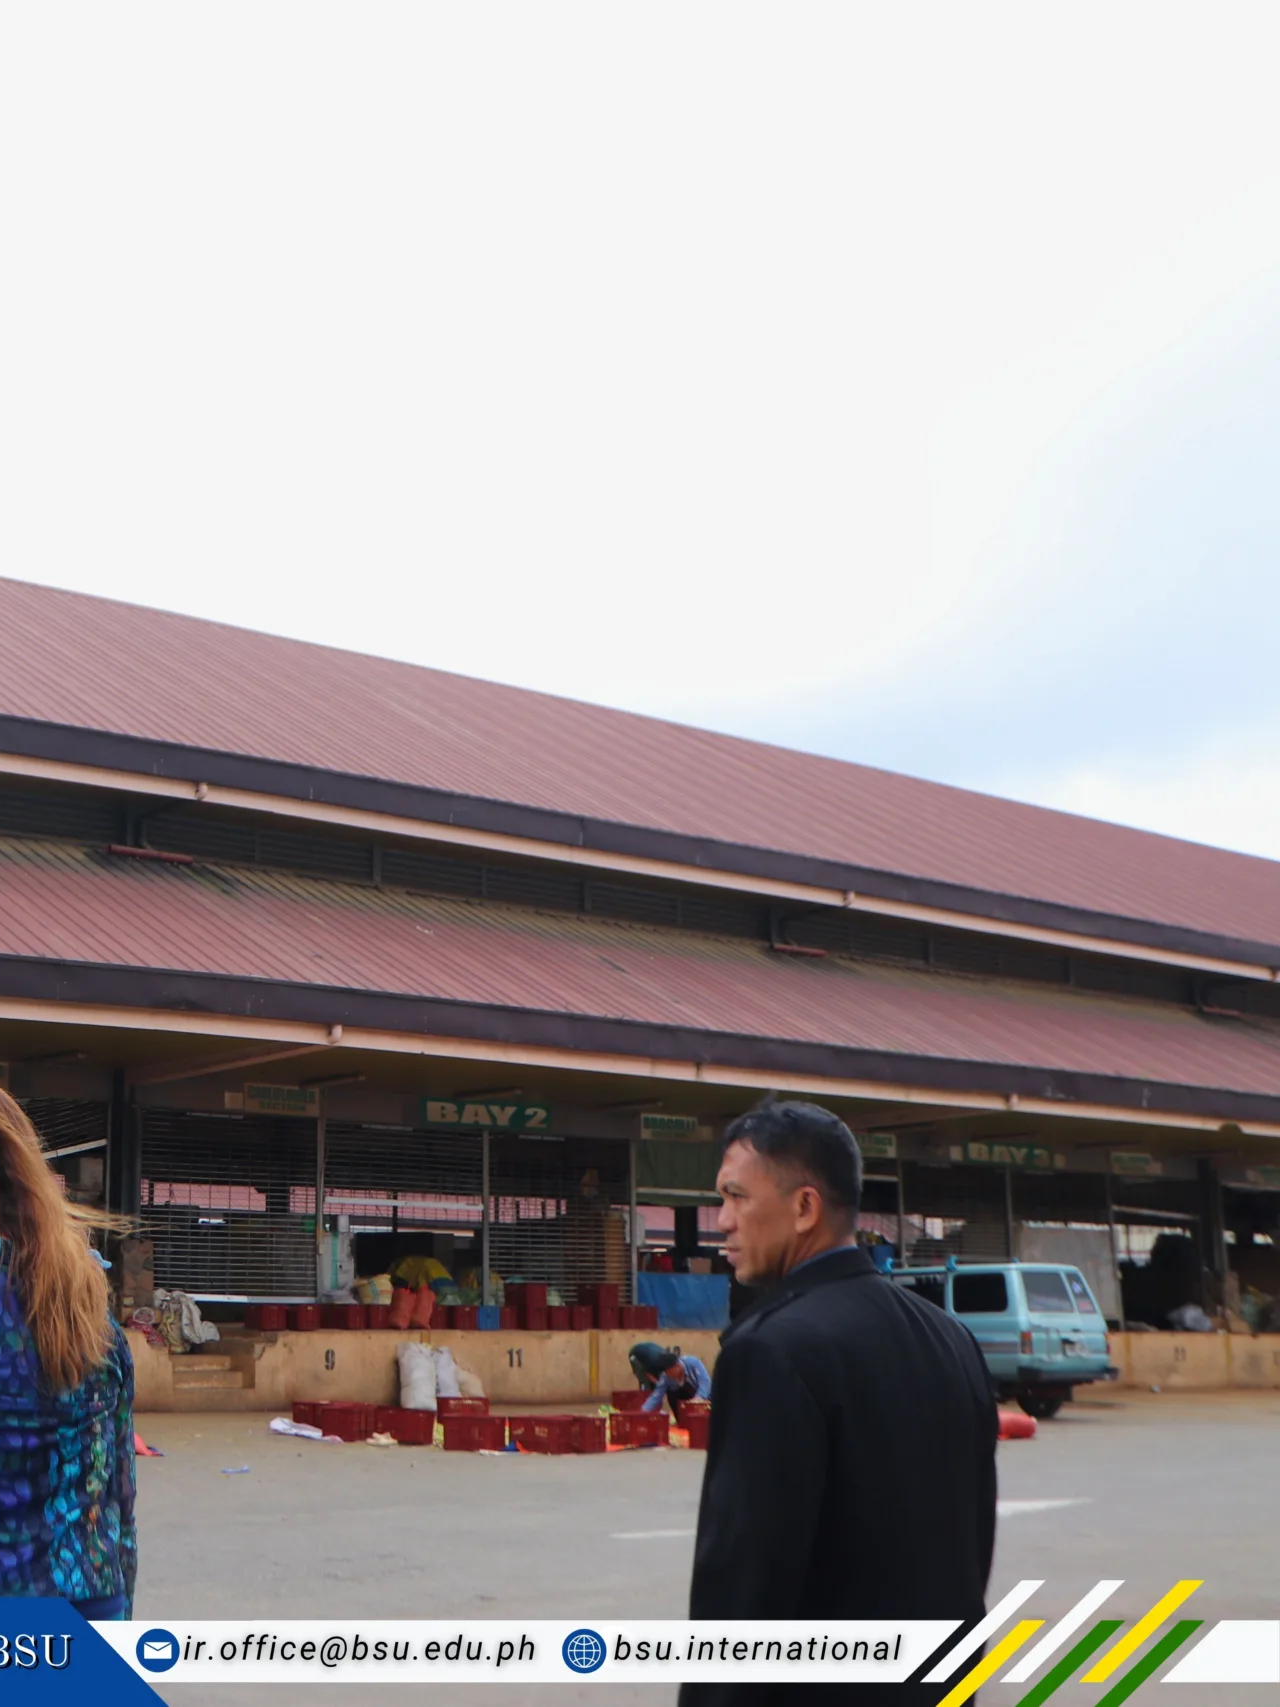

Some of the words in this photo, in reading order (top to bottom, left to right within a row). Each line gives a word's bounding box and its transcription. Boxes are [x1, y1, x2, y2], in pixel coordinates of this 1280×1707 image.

[426, 1101, 517, 1126] BAY
[524, 1107, 547, 1128] 2
[968, 1142, 1028, 1165] BAY
[1033, 1148, 1050, 1167] 3
[324, 1349, 335, 1371] 9
[507, 1348, 522, 1368] 11
